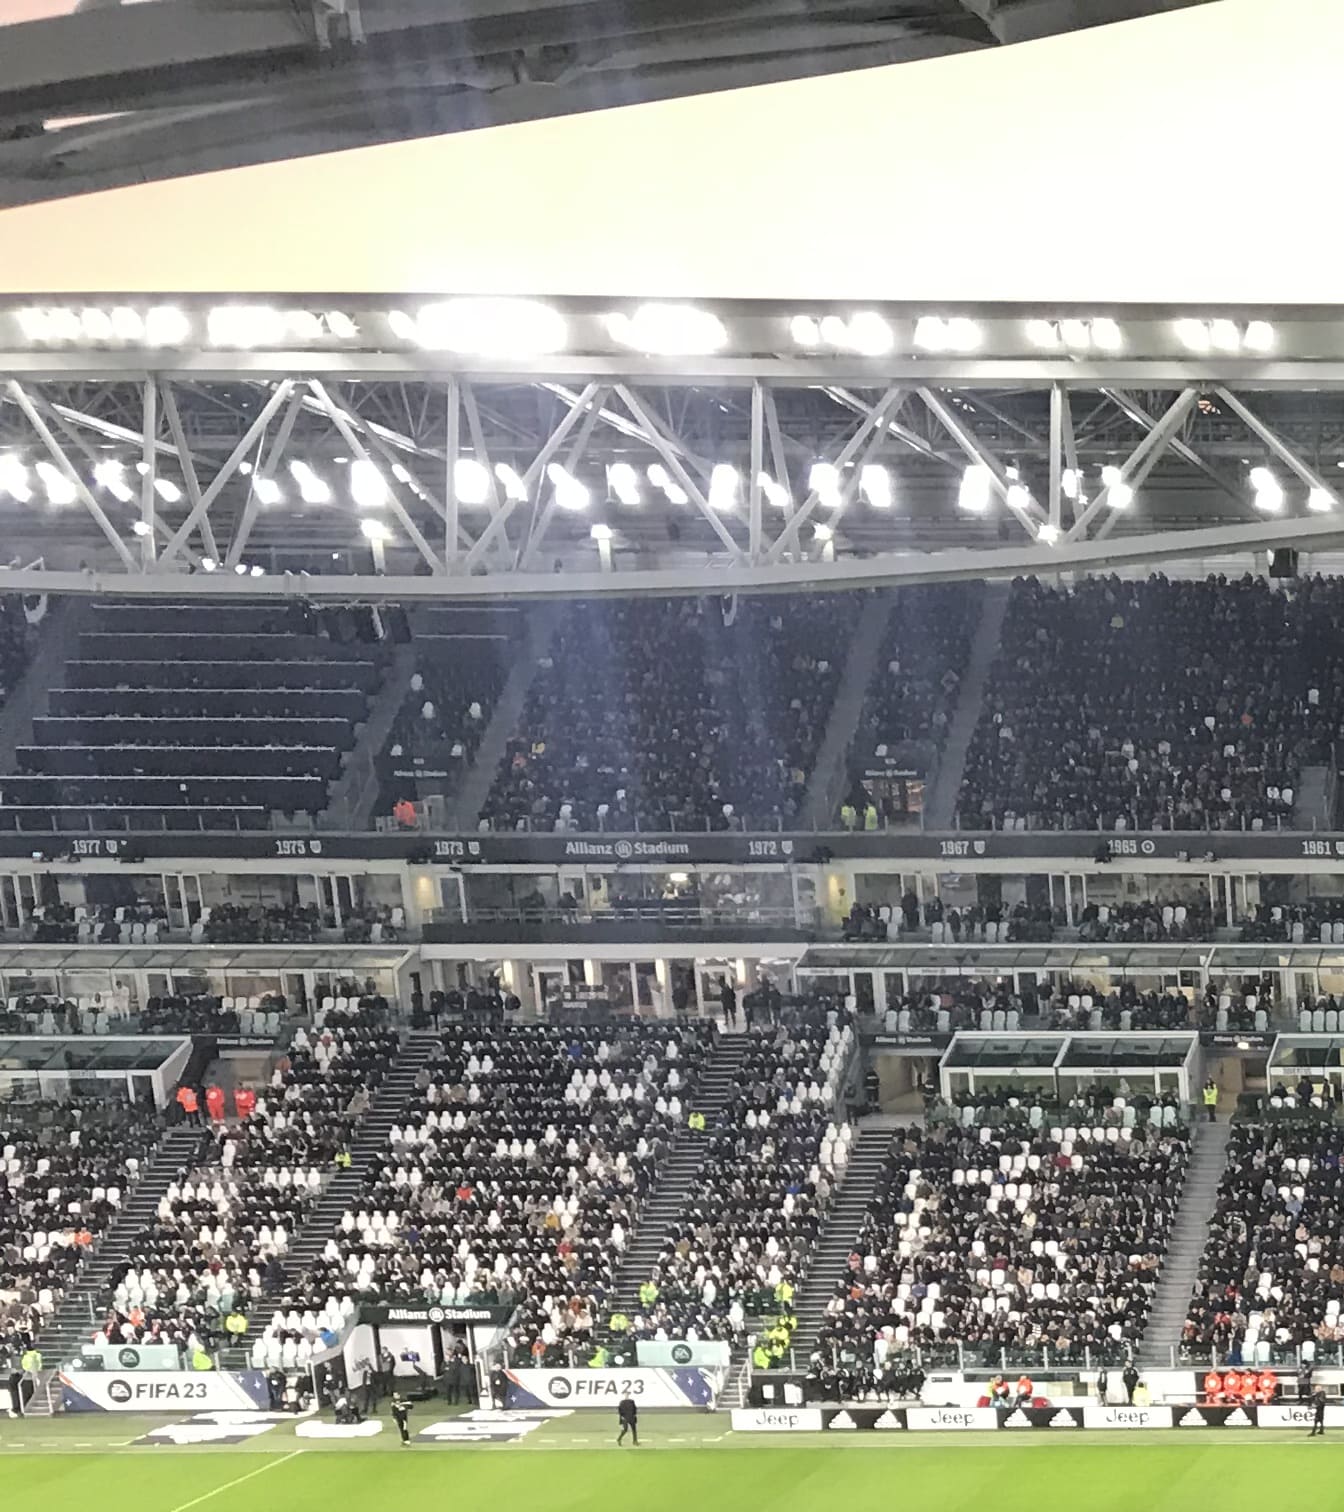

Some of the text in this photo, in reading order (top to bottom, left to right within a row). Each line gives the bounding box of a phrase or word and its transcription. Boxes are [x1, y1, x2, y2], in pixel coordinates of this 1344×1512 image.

[73, 840, 100, 853] 1977
[276, 840, 305, 854] 1975
[435, 841, 463, 855] 1973
[566, 842, 688, 854] Allianz Stadium
[749, 841, 776, 855] 1972
[941, 841, 969, 854] 1967
[1107, 840, 1137, 854] 1965
[1303, 841, 1331, 854] 1961
[388, 1308, 491, 1320] Allianz Stadium
[136, 1384, 179, 1398] FIFA
[184, 1383, 206, 1398] 23
[576, 1380, 617, 1394] FIFA
[622, 1380, 645, 1395] 23
[756, 1412, 799, 1428] Jeep
[931, 1409, 975, 1427] Jeep
[1106, 1407, 1150, 1426] Jeep
[1281, 1407, 1313, 1422] Jee
